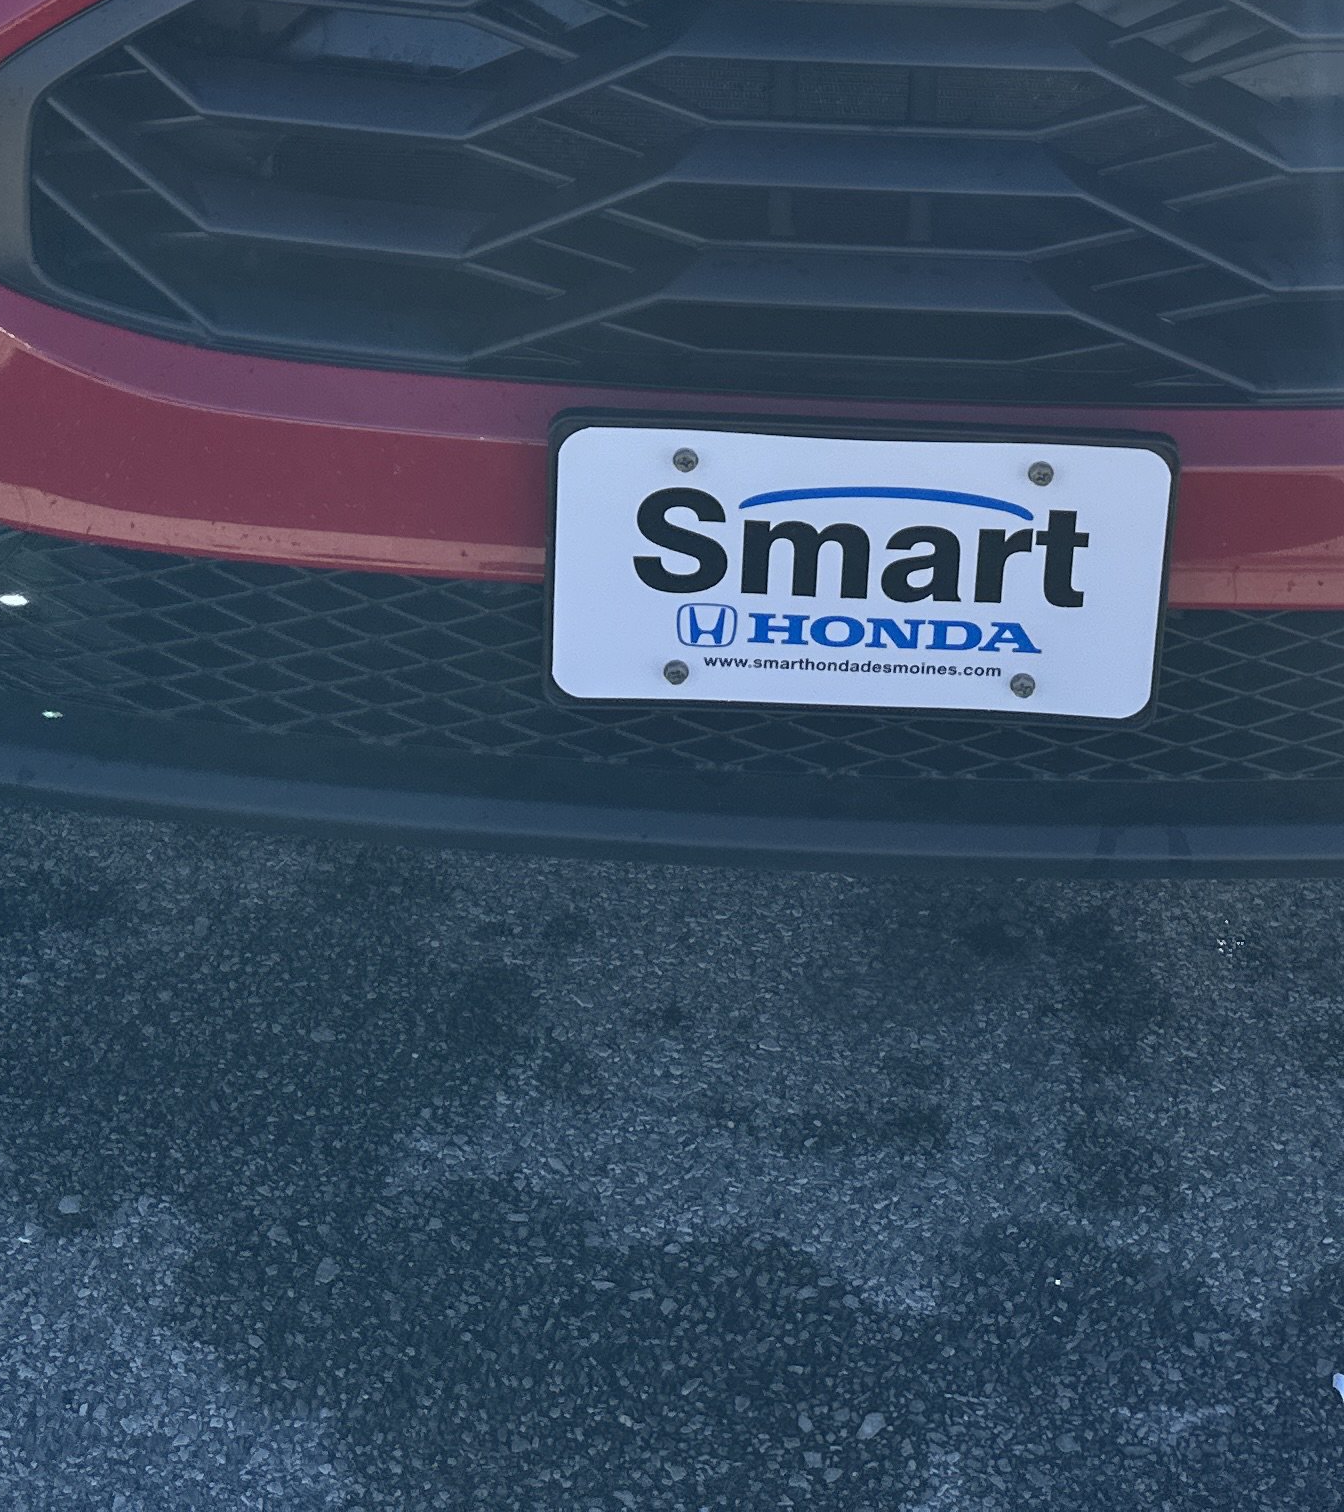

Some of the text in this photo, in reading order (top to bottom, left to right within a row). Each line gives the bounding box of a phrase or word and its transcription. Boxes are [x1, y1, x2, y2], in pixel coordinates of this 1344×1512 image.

[633, 487, 1089, 608] Smart
[747, 612, 1042, 655] HONDA
[703, 655, 1002, 678] www.smarthondadesmoines.com
